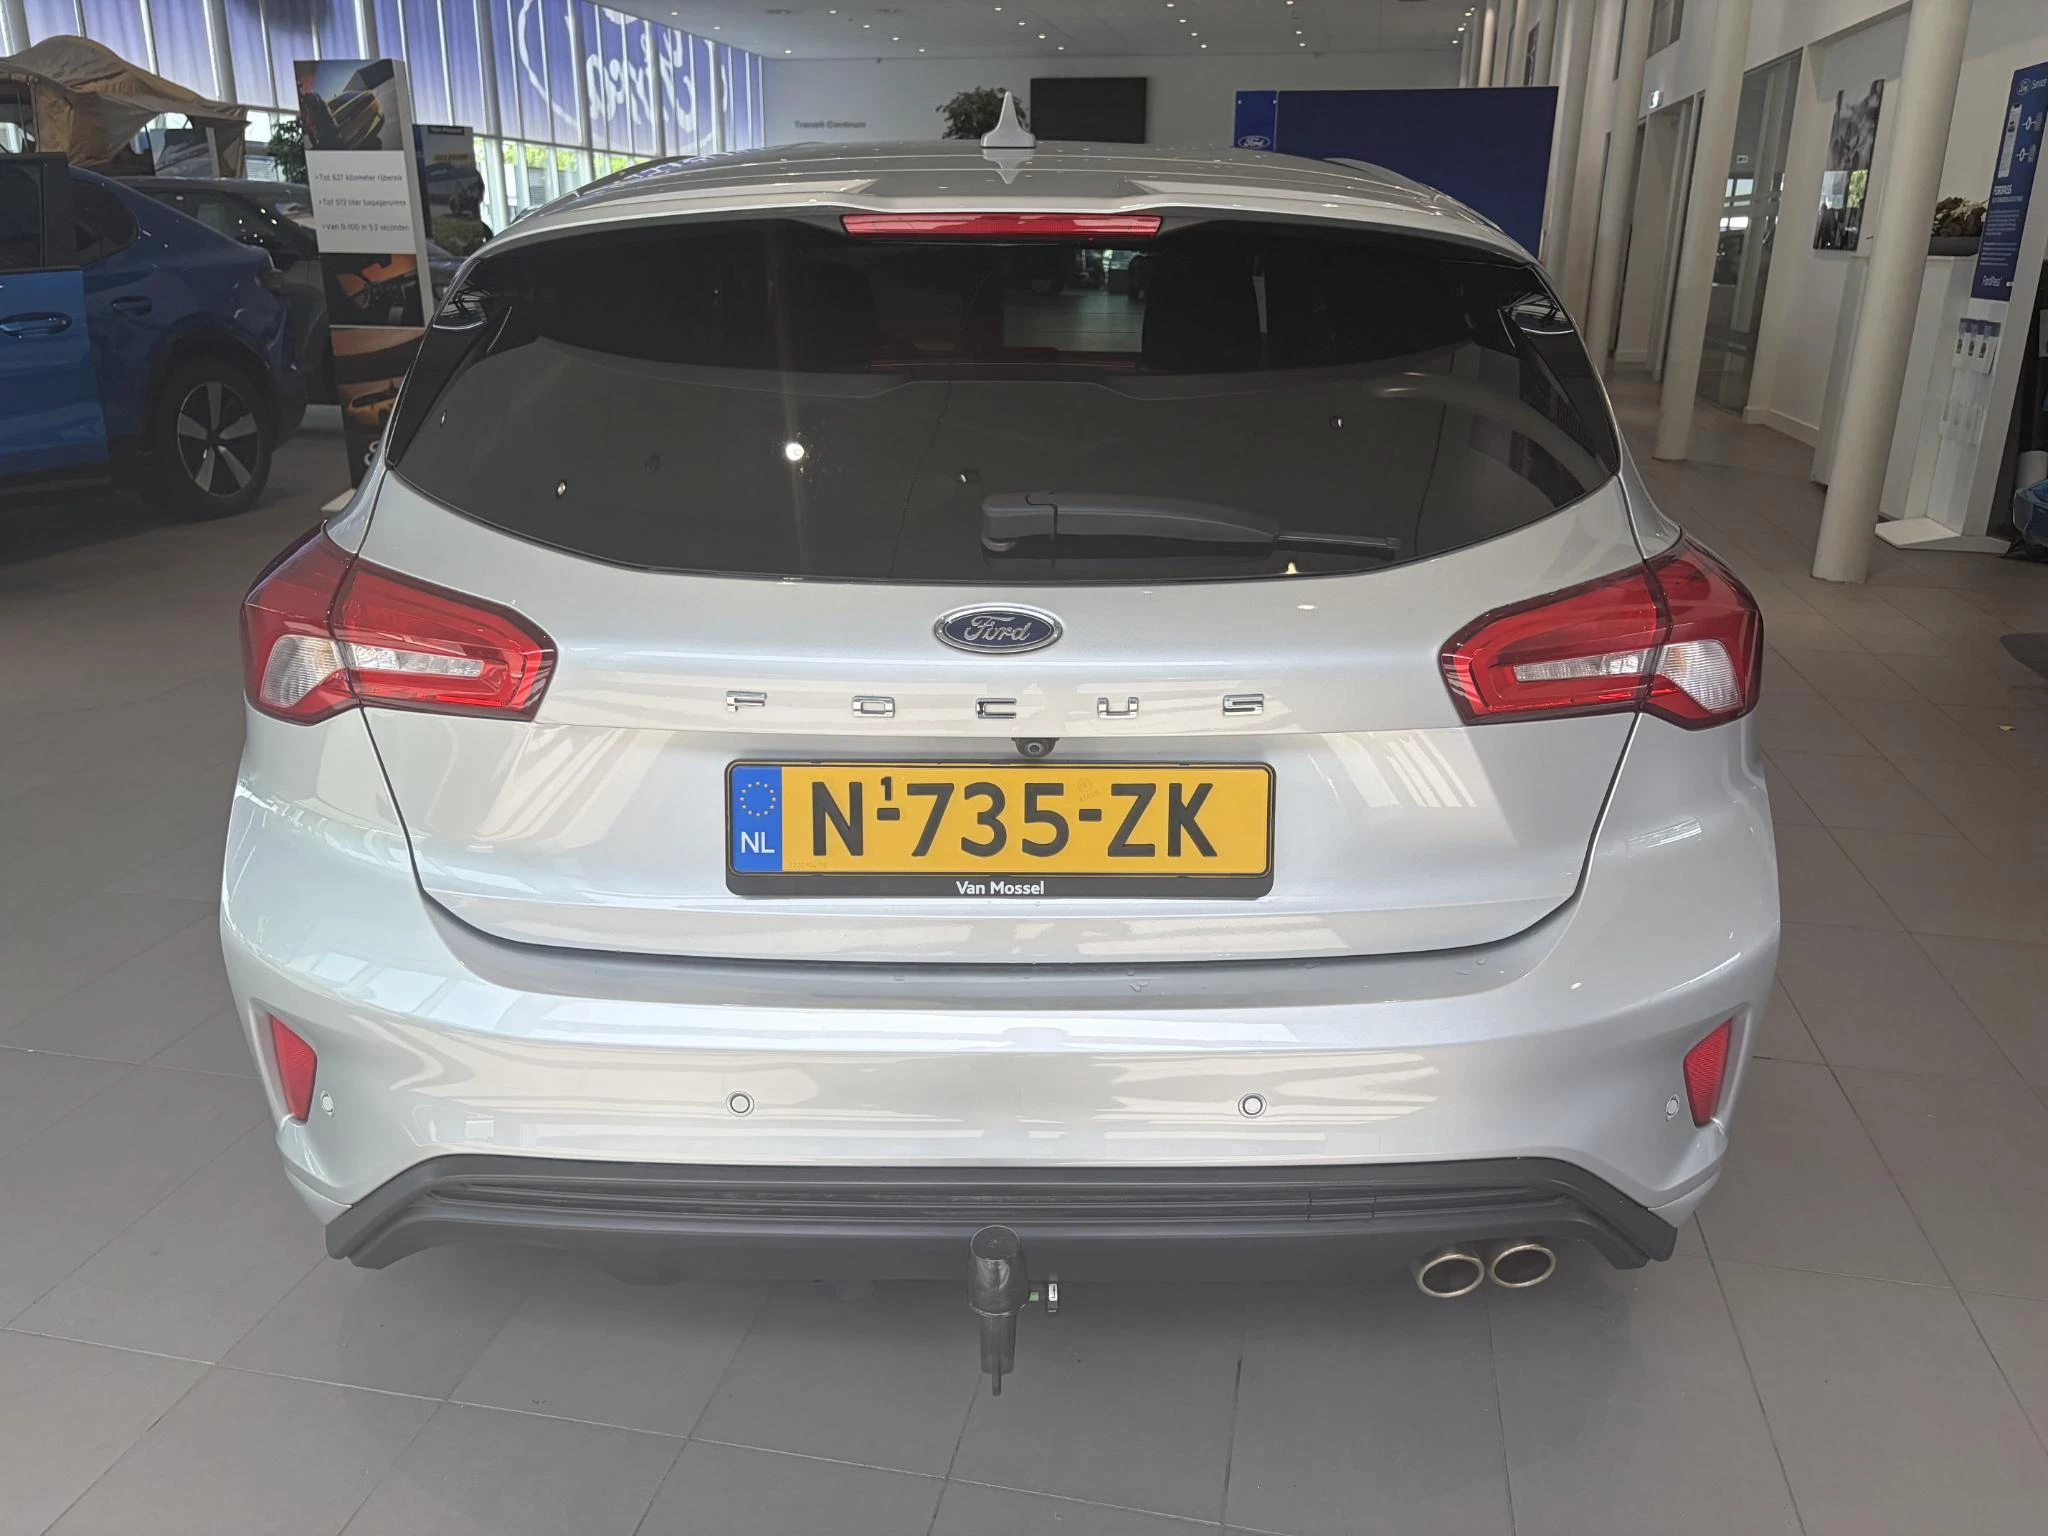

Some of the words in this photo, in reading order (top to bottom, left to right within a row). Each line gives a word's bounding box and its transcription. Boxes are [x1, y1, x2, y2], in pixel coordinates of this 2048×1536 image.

[963, 615, 1033, 641] Ford
[725, 690, 1266, 719] FOCUS
[740, 831, 775, 854] NL
[956, 881, 985, 895] Van
[990, 881, 1045, 896] Mossel
